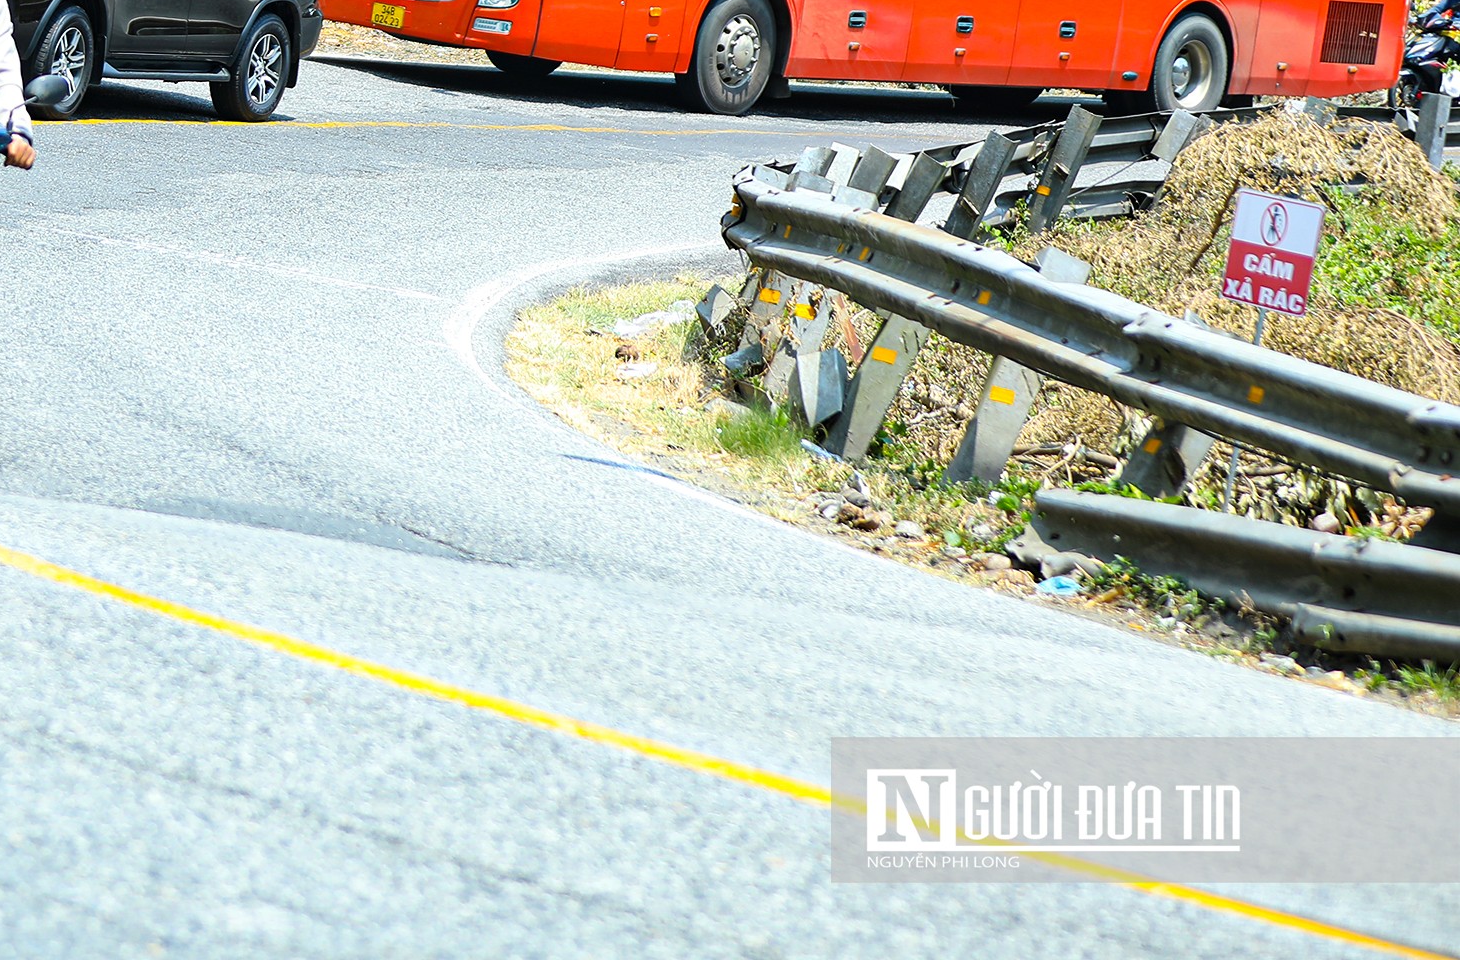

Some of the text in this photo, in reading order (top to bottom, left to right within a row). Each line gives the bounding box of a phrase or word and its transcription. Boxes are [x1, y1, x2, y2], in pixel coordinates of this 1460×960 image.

[381, 4, 396, 16] 34B
[1243, 252, 1295, 282] CẤM
[1223, 276, 1305, 313] XẢ RÁC
